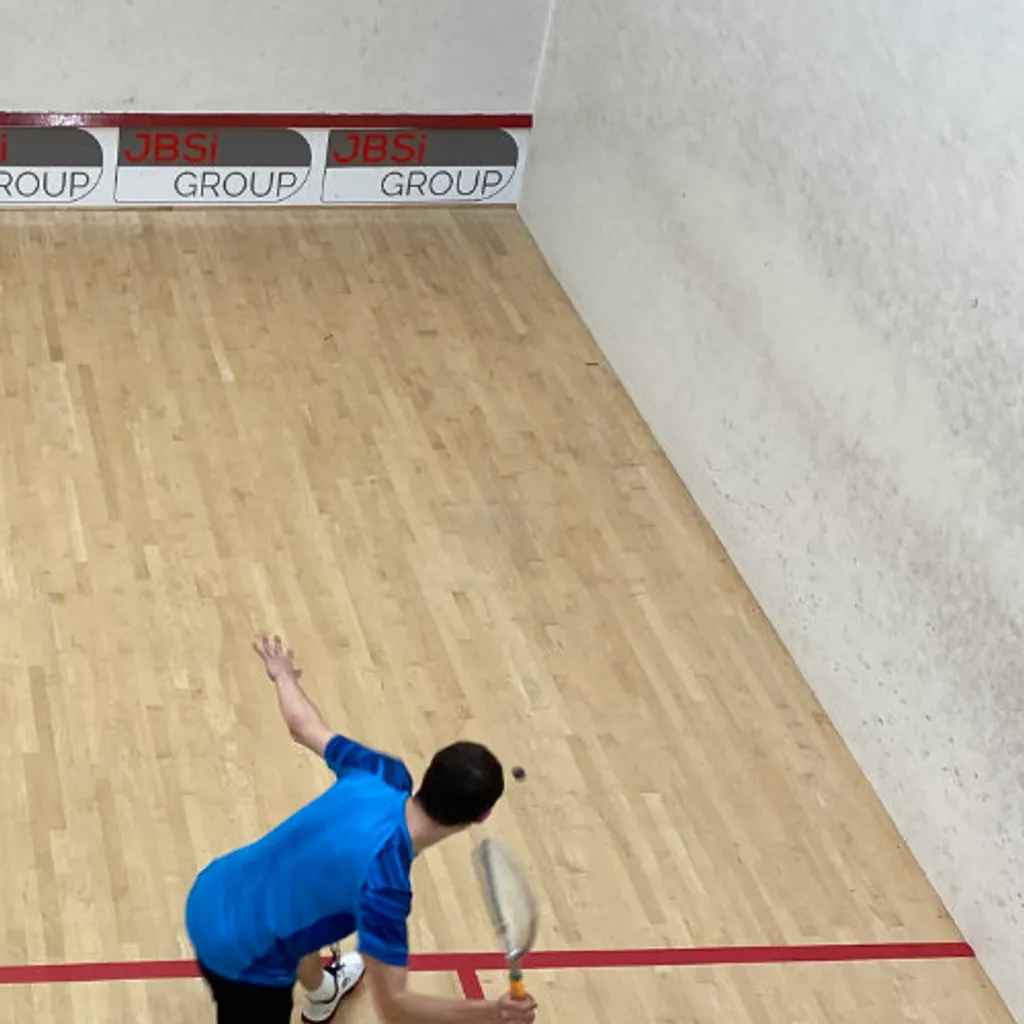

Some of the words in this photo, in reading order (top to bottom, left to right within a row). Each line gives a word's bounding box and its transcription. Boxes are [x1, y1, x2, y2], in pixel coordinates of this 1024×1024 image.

[124, 132, 219, 163] JBSi
[332, 132, 427, 164] JBSi
[173, 171, 297, 198] GROUP
[379, 171, 504, 198] GROUP
